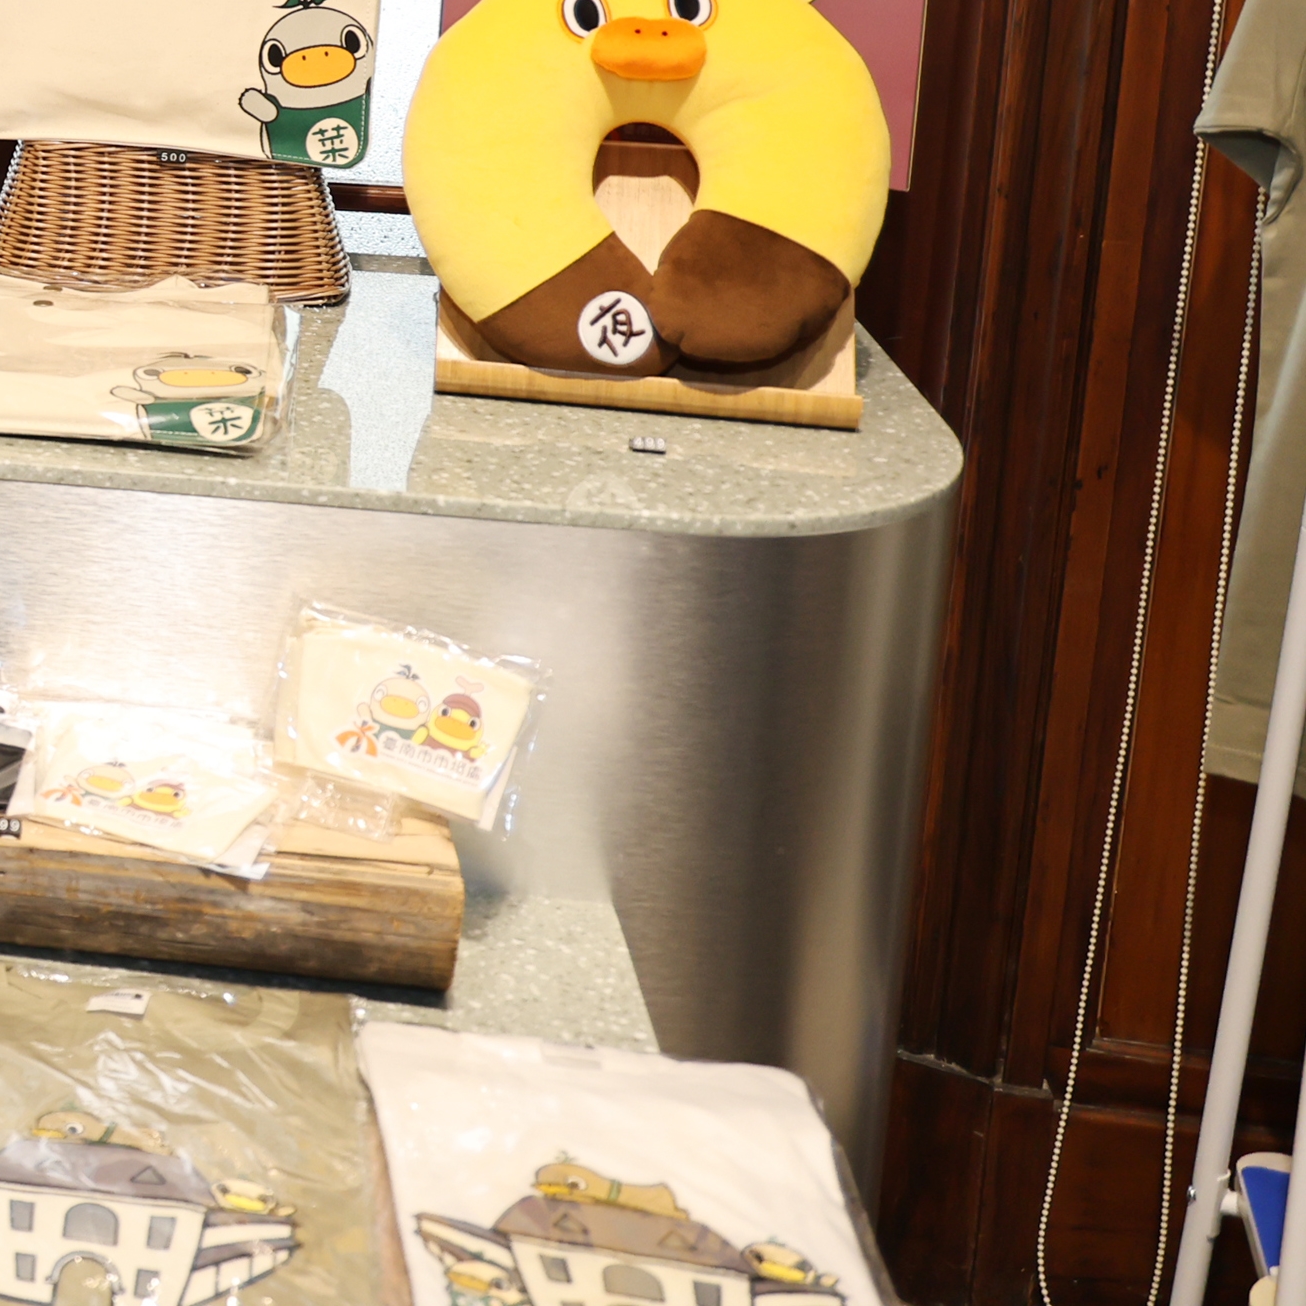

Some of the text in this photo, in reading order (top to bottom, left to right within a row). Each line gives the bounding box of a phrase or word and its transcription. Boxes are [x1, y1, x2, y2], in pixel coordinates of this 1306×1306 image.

[160, 152, 187, 163] 500
[311, 124, 350, 163] 菜
[589, 297, 646, 358] 夜
